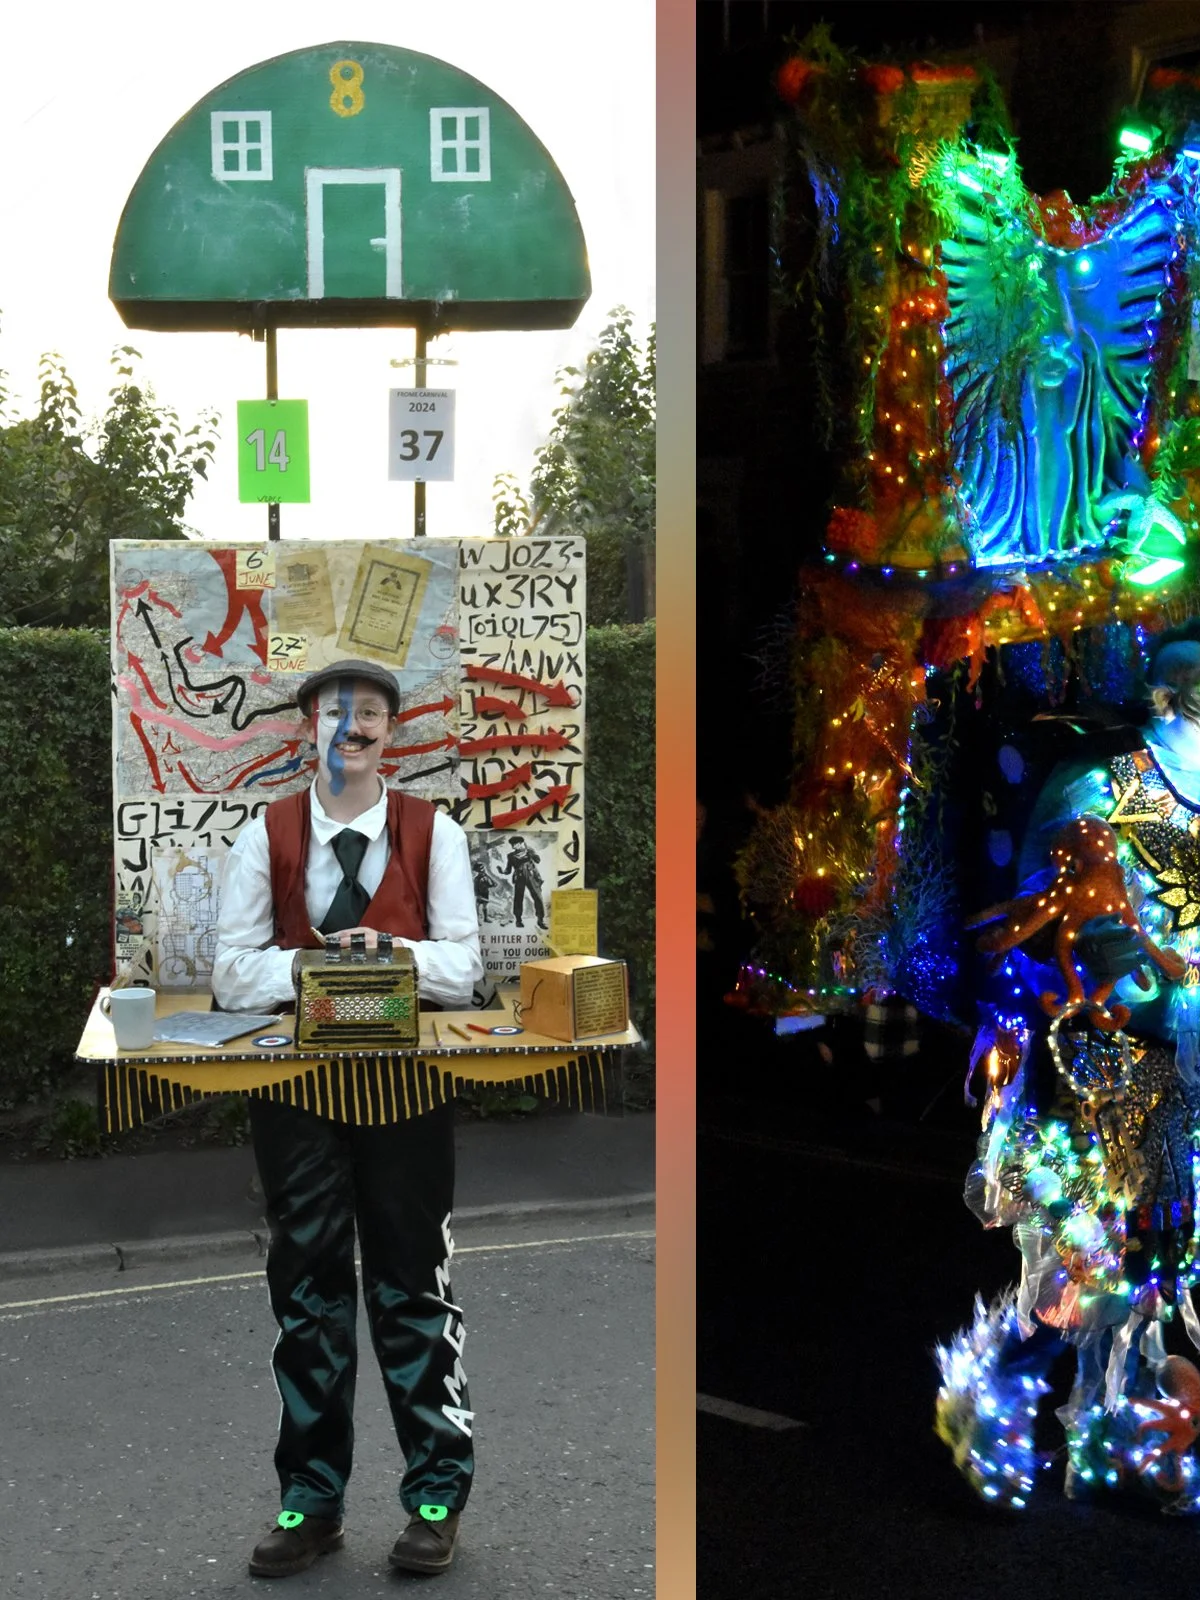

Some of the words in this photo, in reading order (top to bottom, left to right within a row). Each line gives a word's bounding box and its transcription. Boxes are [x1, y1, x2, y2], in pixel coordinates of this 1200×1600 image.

[329, 60, 365, 118] 8
[408, 402, 436, 413] 2024
[245, 429, 290, 472] 14
[400, 430, 444, 461] 37
[239, 571, 274, 586] JUNE
[269, 658, 306, 671] JUNE
[491, 935, 522, 944] HITLER
[526, 935, 538, 944] TO
[503, 948, 521, 957] YOU
[524, 948, 551, 957] OUGH
[486, 961, 503, 971] OUT
[505, 961, 517, 971] OF
